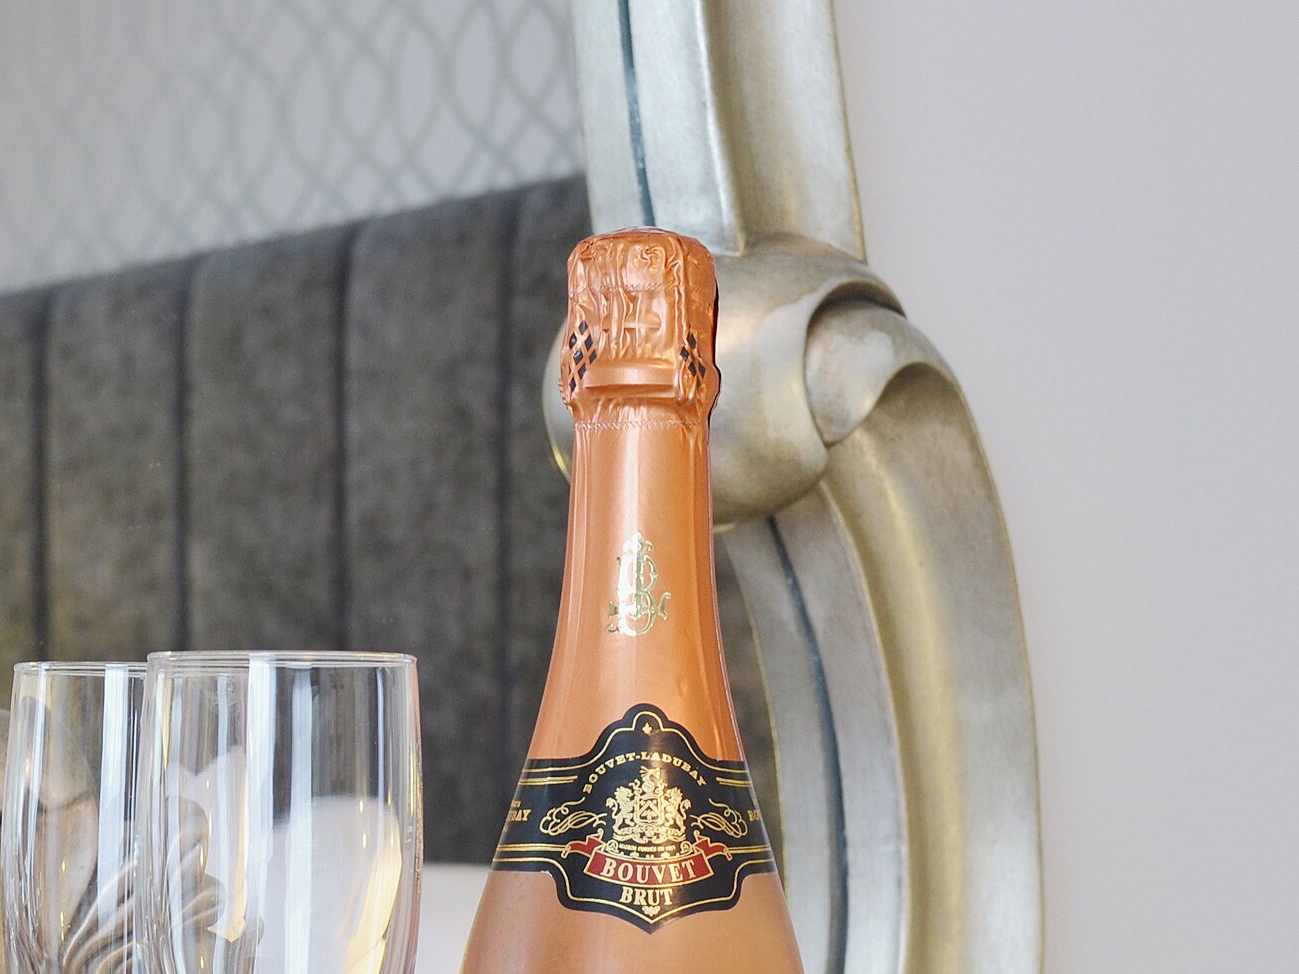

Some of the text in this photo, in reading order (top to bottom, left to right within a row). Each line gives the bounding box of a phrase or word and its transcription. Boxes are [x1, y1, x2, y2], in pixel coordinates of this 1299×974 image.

[582, 752, 707, 794] BOUVET-LADUBAY
[600, 860, 697, 884] BOUVET
[619, 886, 673, 906] BRUT
